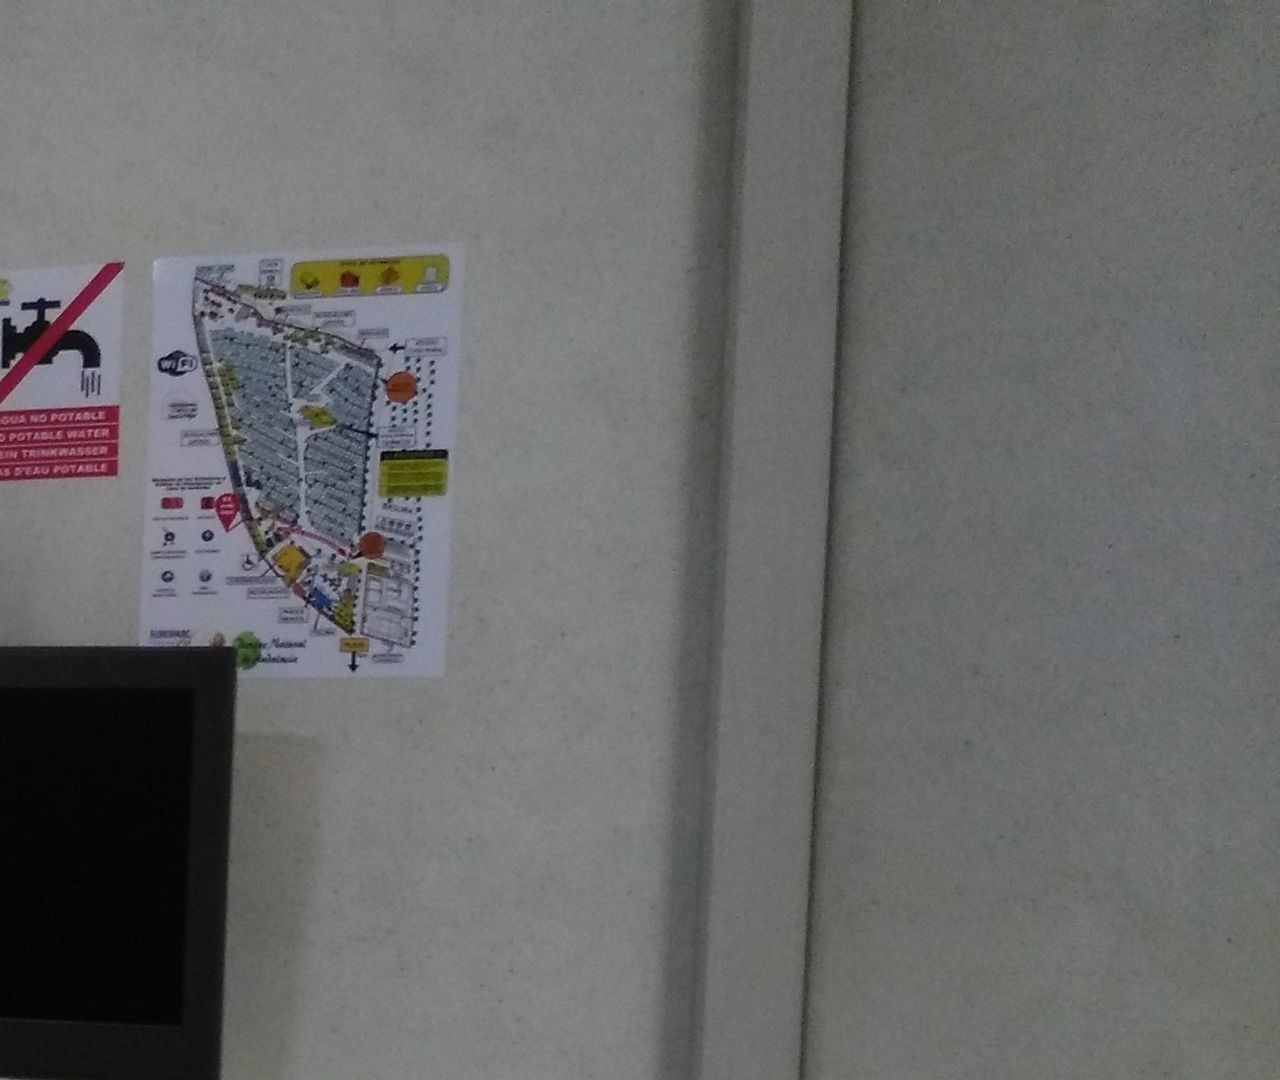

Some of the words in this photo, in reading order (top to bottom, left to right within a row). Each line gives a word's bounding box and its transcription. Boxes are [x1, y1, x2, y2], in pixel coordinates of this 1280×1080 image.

[30, 414, 47, 423] NO
[51, 411, 106, 422] POTABLE
[9, 430, 64, 442] POTABLE
[66, 428, 110, 440] WATER
[21, 446, 109, 458] TRINKWASSER
[14, 466, 50, 476] D'EAU
[53, 463, 109, 475] POTABLE
